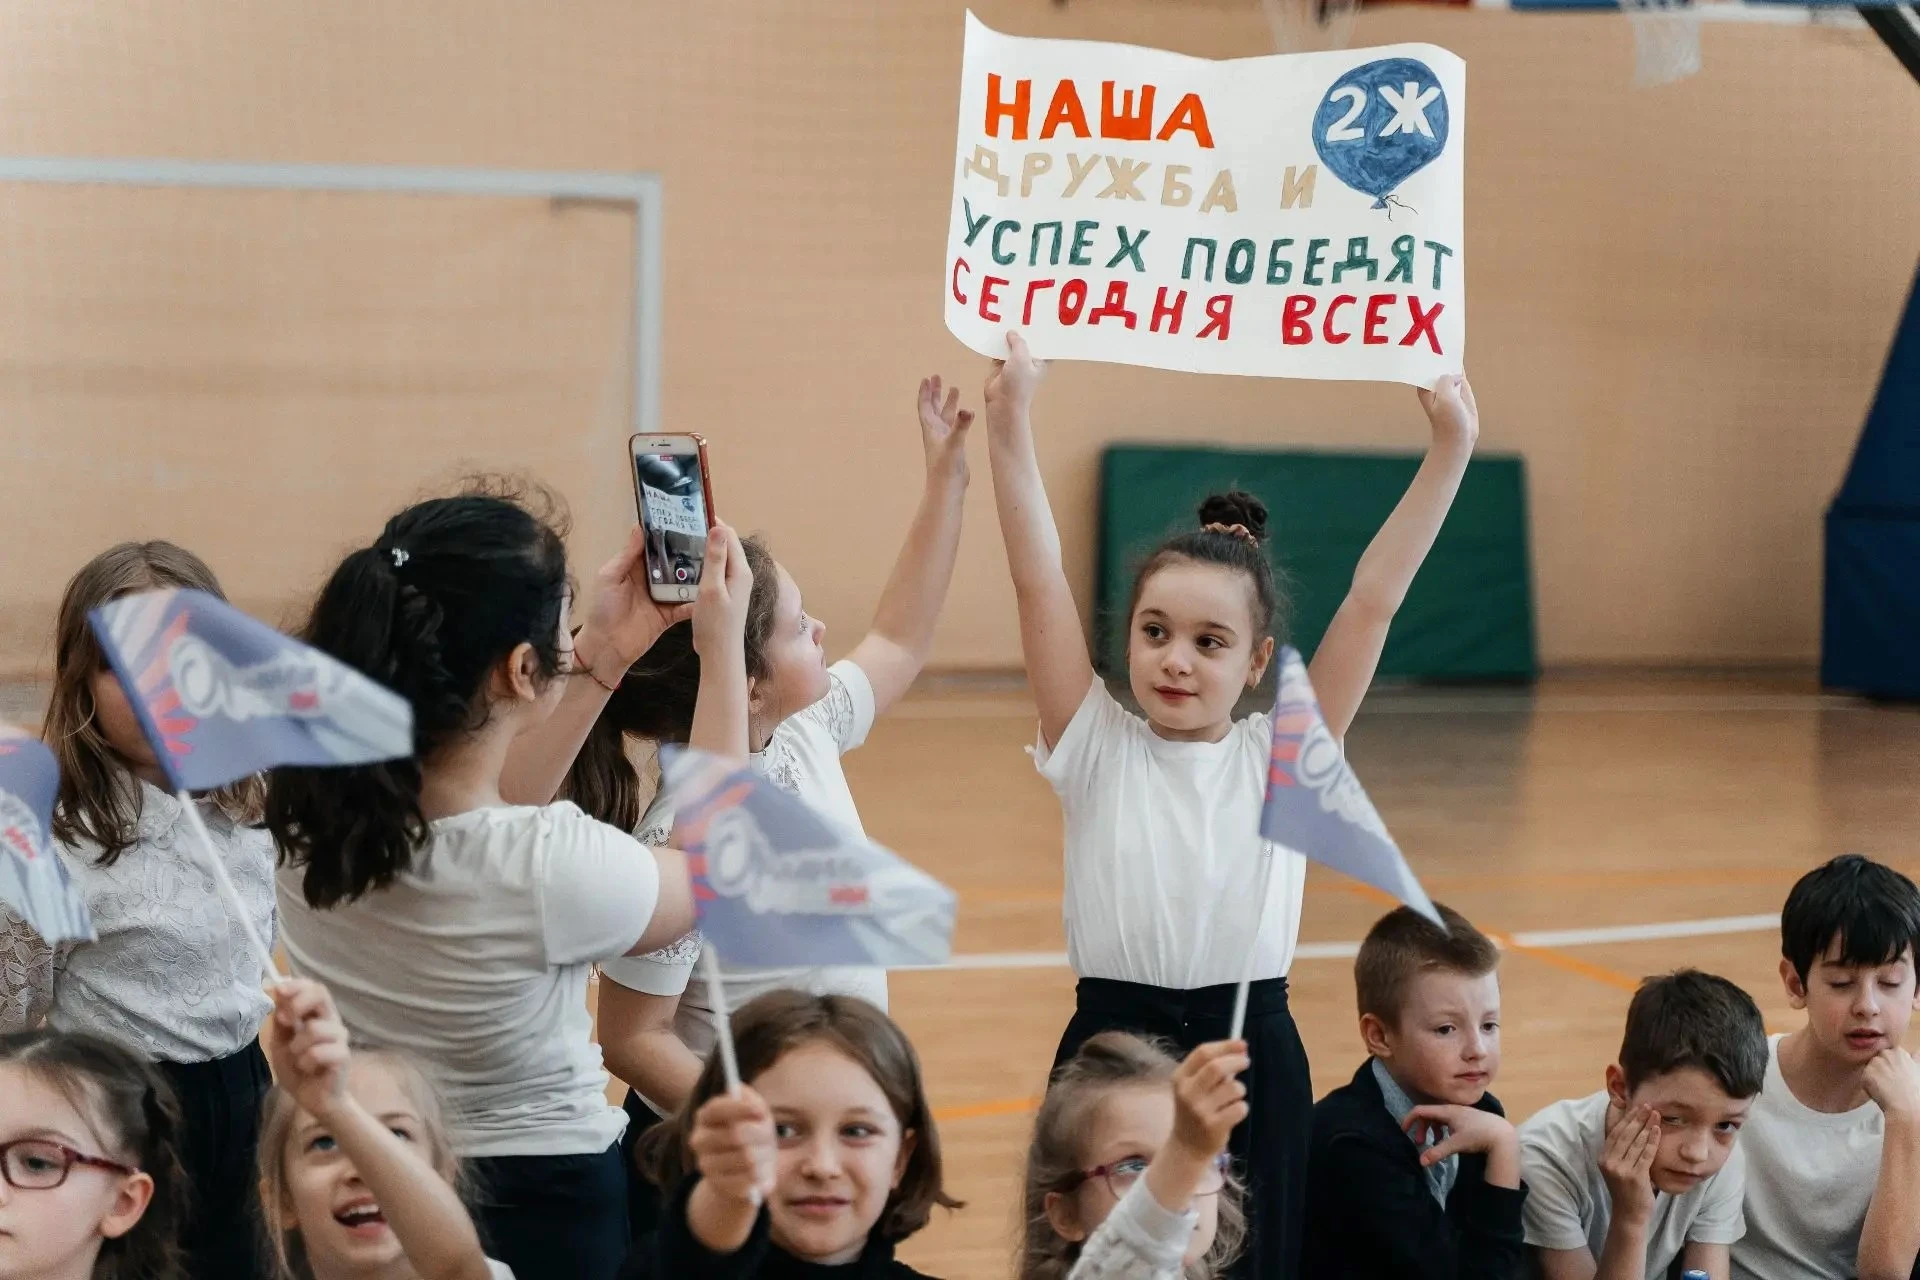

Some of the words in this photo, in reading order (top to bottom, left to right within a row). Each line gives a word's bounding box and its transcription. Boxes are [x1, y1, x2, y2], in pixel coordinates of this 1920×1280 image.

[984, 72, 1215, 149] НАША
[1326, 81, 1441, 142] 2Ж
[963, 143, 1238, 213] ДРУЖБА
[1280, 164, 1318, 210] И
[961, 197, 1151, 273] УСПЕХ
[1180, 233, 1454, 291] ПОБЕДЯТ
[952, 256, 1234, 342] СЕГОДНЯ
[1281, 293, 1445, 356] ВСЕХ
